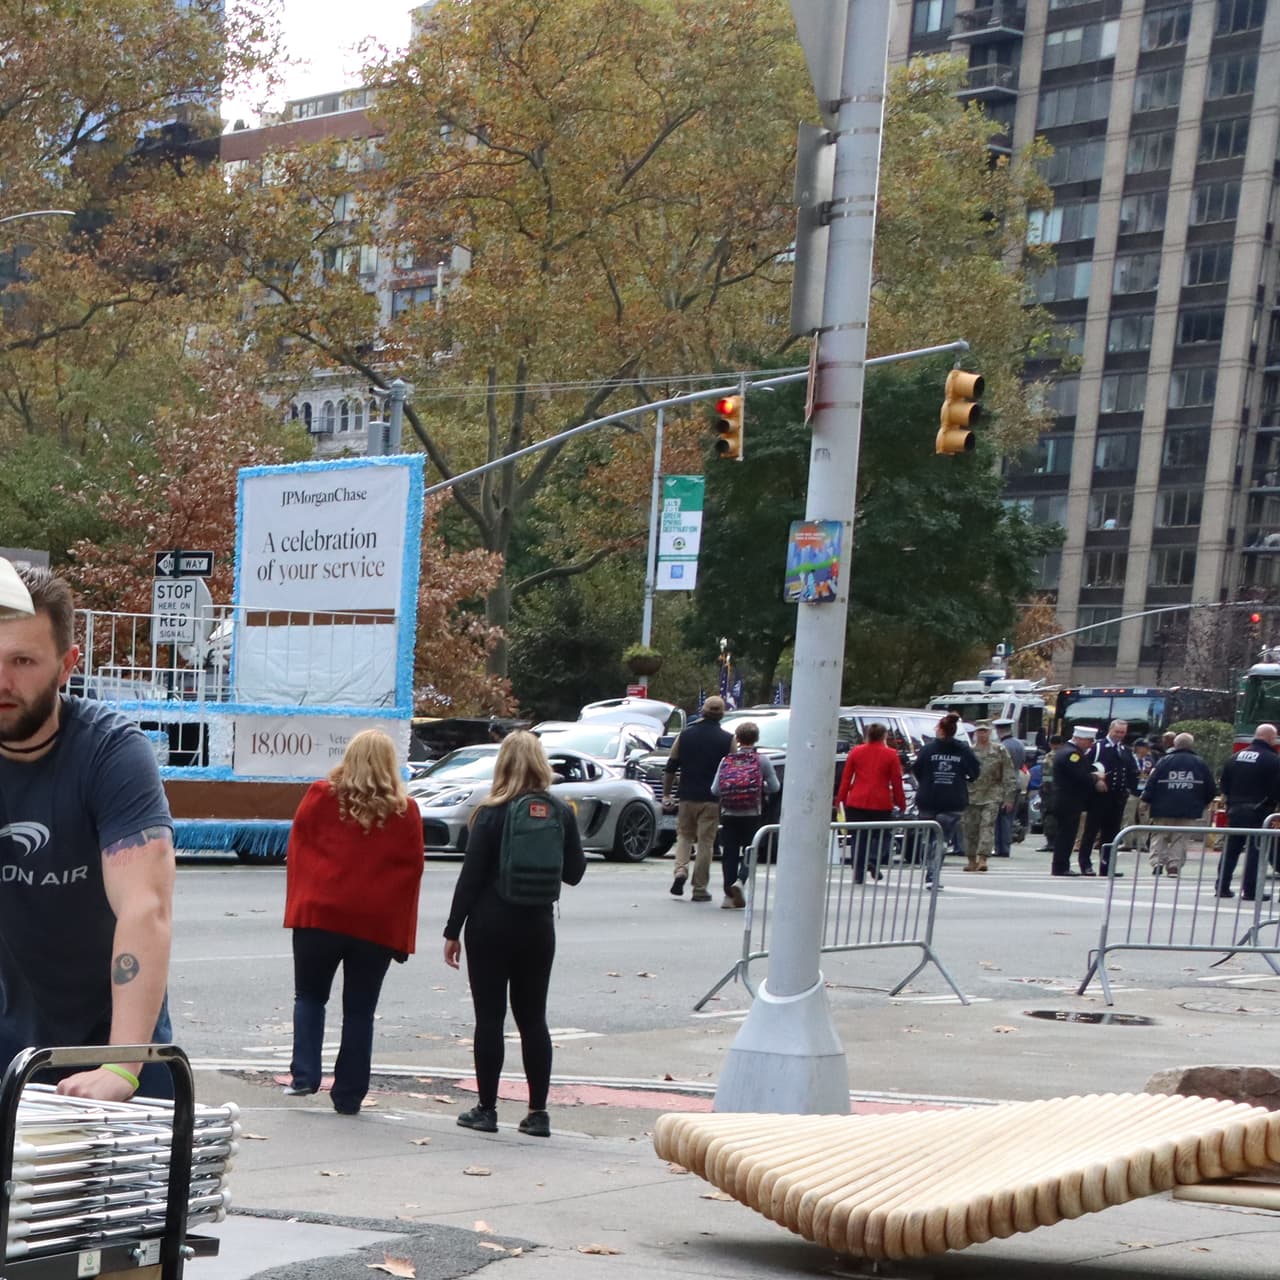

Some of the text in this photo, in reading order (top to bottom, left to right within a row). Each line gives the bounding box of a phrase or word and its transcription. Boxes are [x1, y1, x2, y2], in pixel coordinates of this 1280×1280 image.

[281, 487, 368, 507] JPMorganChase
[262, 527, 378, 553] A celebration
[162, 560, 204, 569] ON WAY
[257, 555, 385, 585] of your service
[157, 584, 193, 599] STOP
[158, 601, 191, 610] HERE ON
[159, 612, 188, 627] RED
[1168, 771, 1194, 780] DEA
[40, 865, 89, 885] AIR
